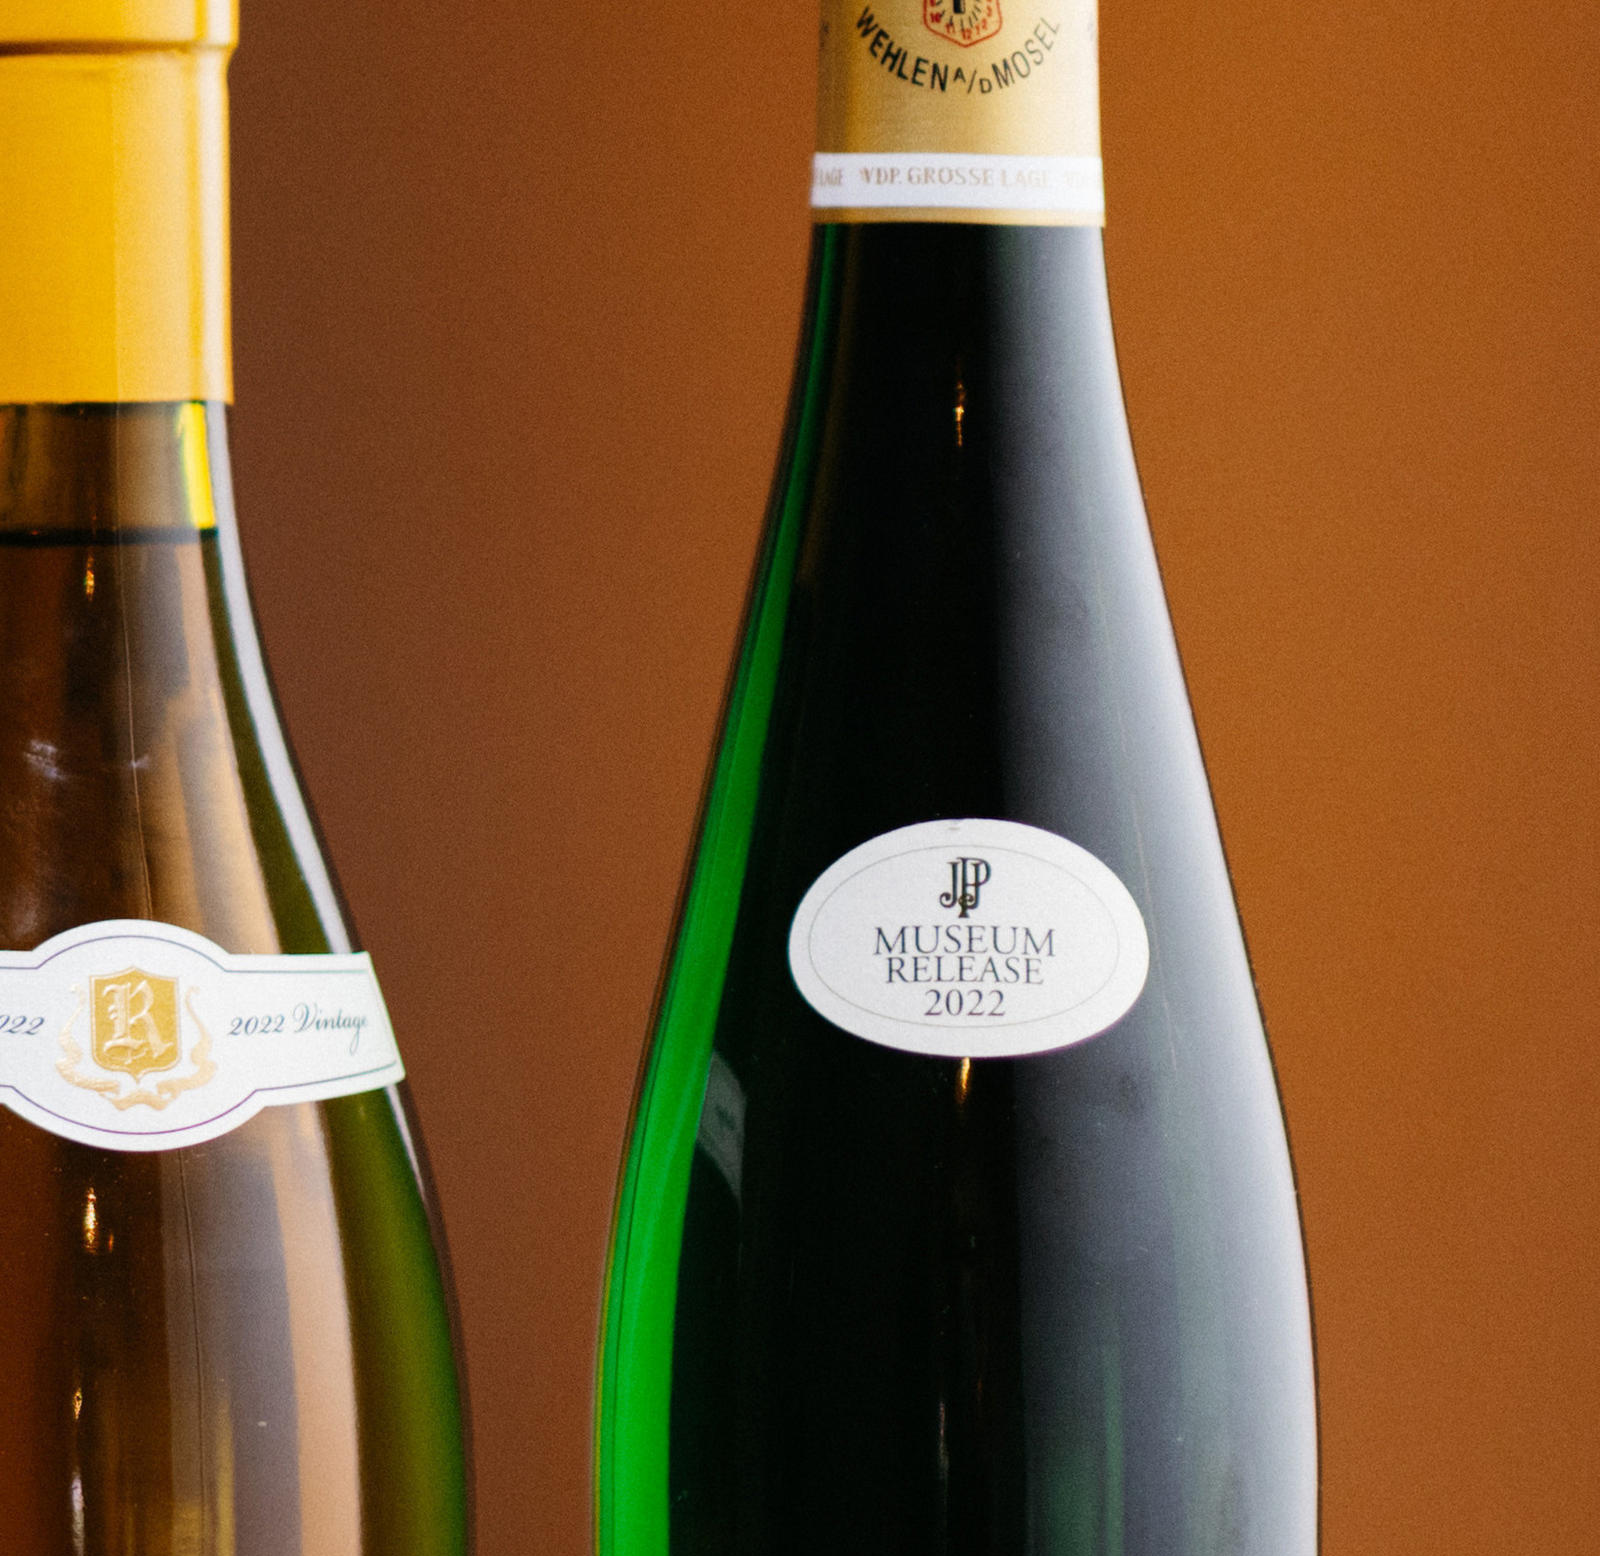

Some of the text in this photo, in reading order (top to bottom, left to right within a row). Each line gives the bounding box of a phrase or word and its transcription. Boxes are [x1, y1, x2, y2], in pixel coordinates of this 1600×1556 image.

[856, 7, 949, 93] WEHLEN
[991, 16, 1061, 90] MOSEL
[907, 166, 994, 187] GROSSE
[873, 925, 1056, 957] MUSEUM
[886, 955, 1044, 985] RELEASE
[924, 988, 1006, 1017] 2022
[227, 1003, 368, 1055] 2022 Vintage
